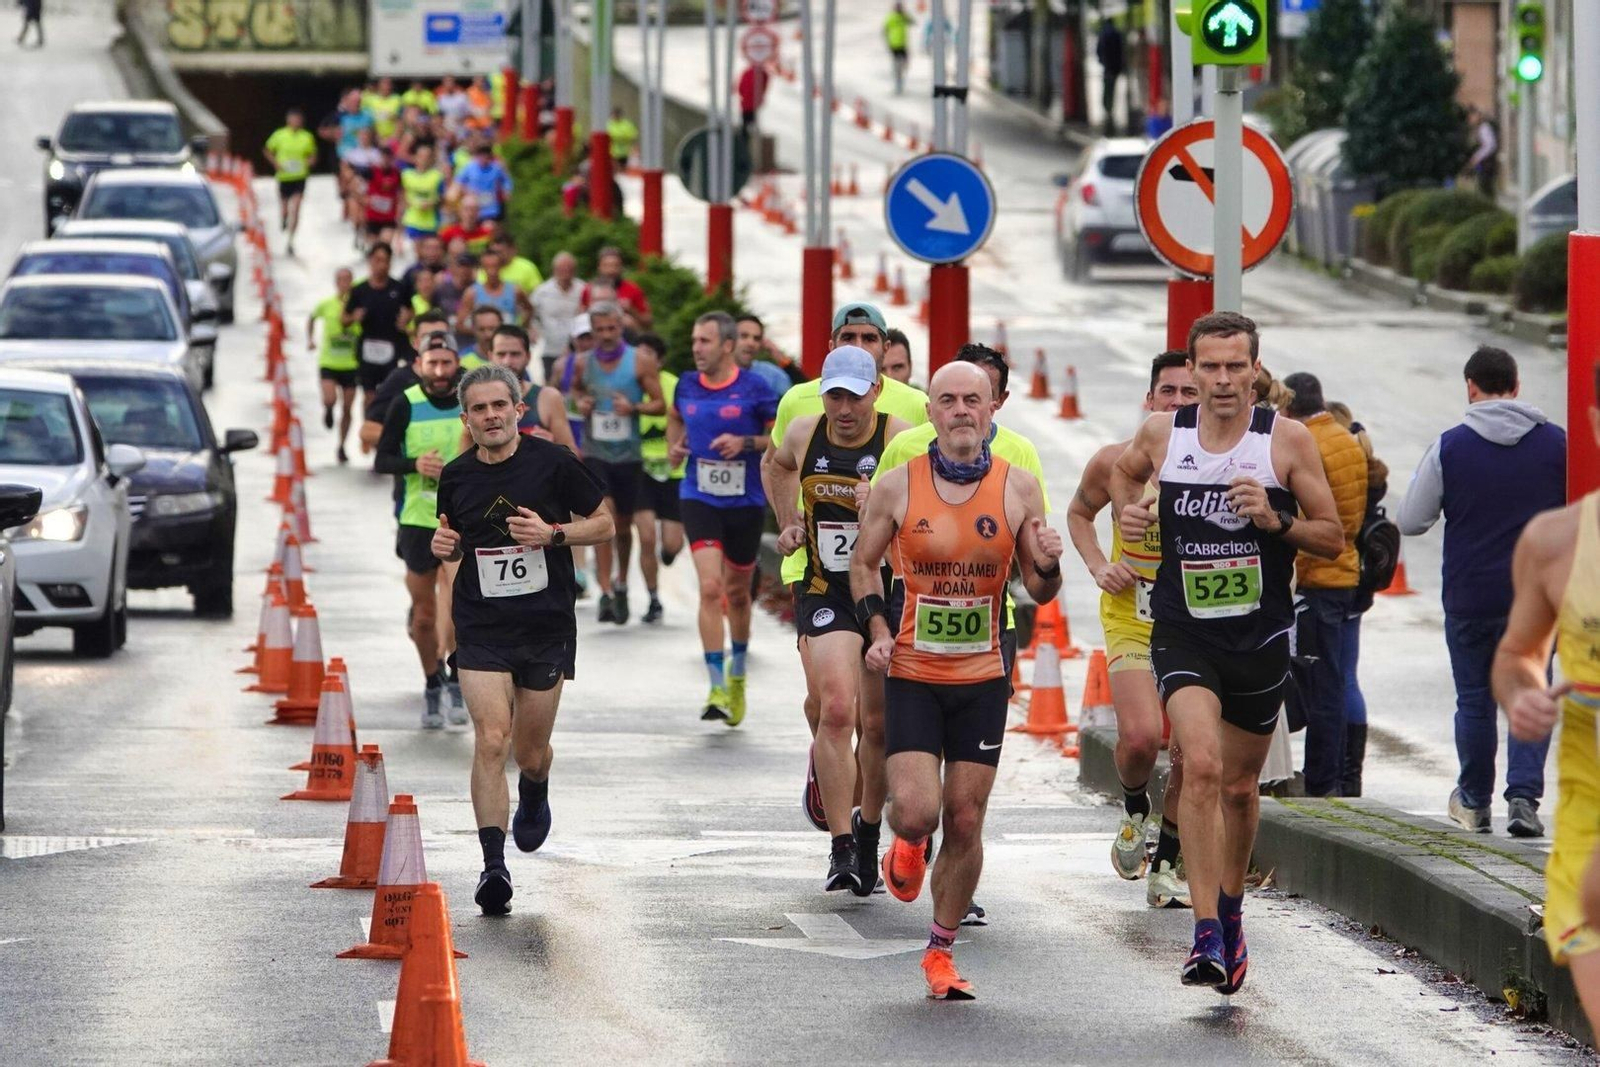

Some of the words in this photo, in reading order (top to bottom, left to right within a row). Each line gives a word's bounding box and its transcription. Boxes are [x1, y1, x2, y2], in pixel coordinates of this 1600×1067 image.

[709, 470, 731, 484] 60
[494, 558, 527, 581] 76
[912, 561, 998, 578] SAMERTOLAMEU
[932, 579, 976, 596] MOAÑA
[1195, 573, 1249, 601] 523
[927, 611, 981, 636] 550
